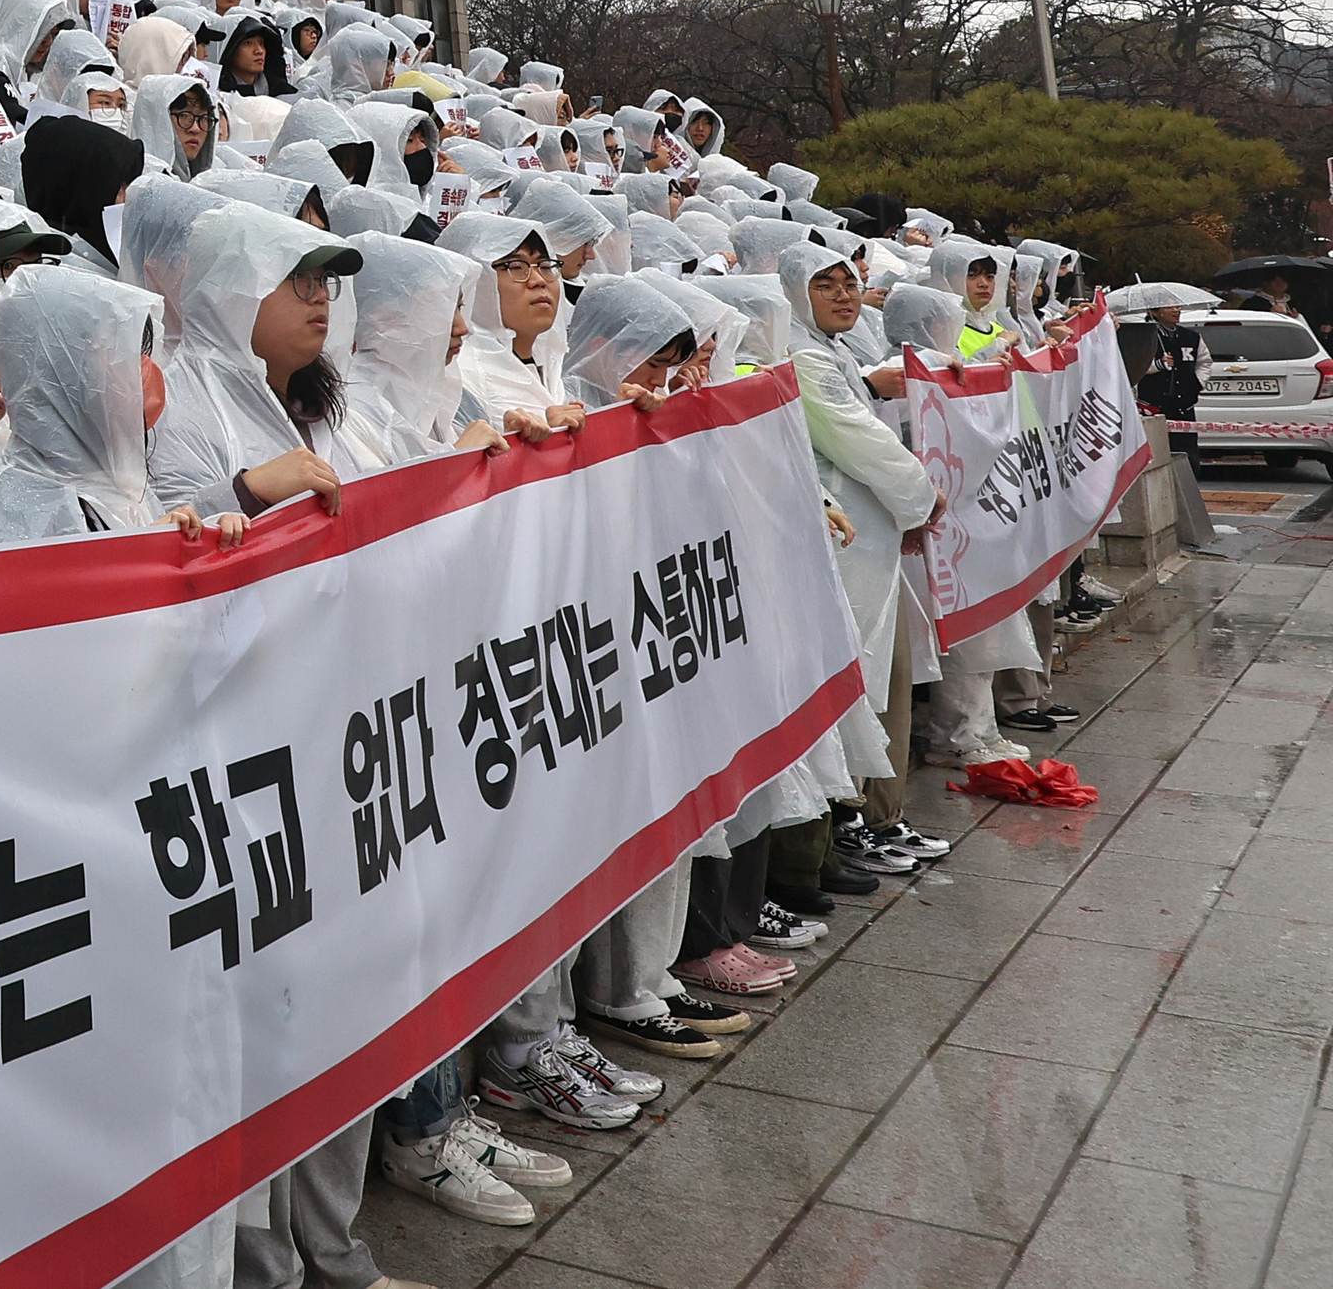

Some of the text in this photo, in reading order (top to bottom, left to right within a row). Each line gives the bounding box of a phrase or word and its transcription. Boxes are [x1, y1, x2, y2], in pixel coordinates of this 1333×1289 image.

[112, 3, 132, 18] 통합
[1181, 347, 1195, 361] K
[1238, 380, 1271, 391] 2045
[134, 745, 313, 971] 학교
[342, 676, 446, 895] 없다
[455, 601, 623, 810] 경북대는
[631, 531, 749, 703] 소통하라
